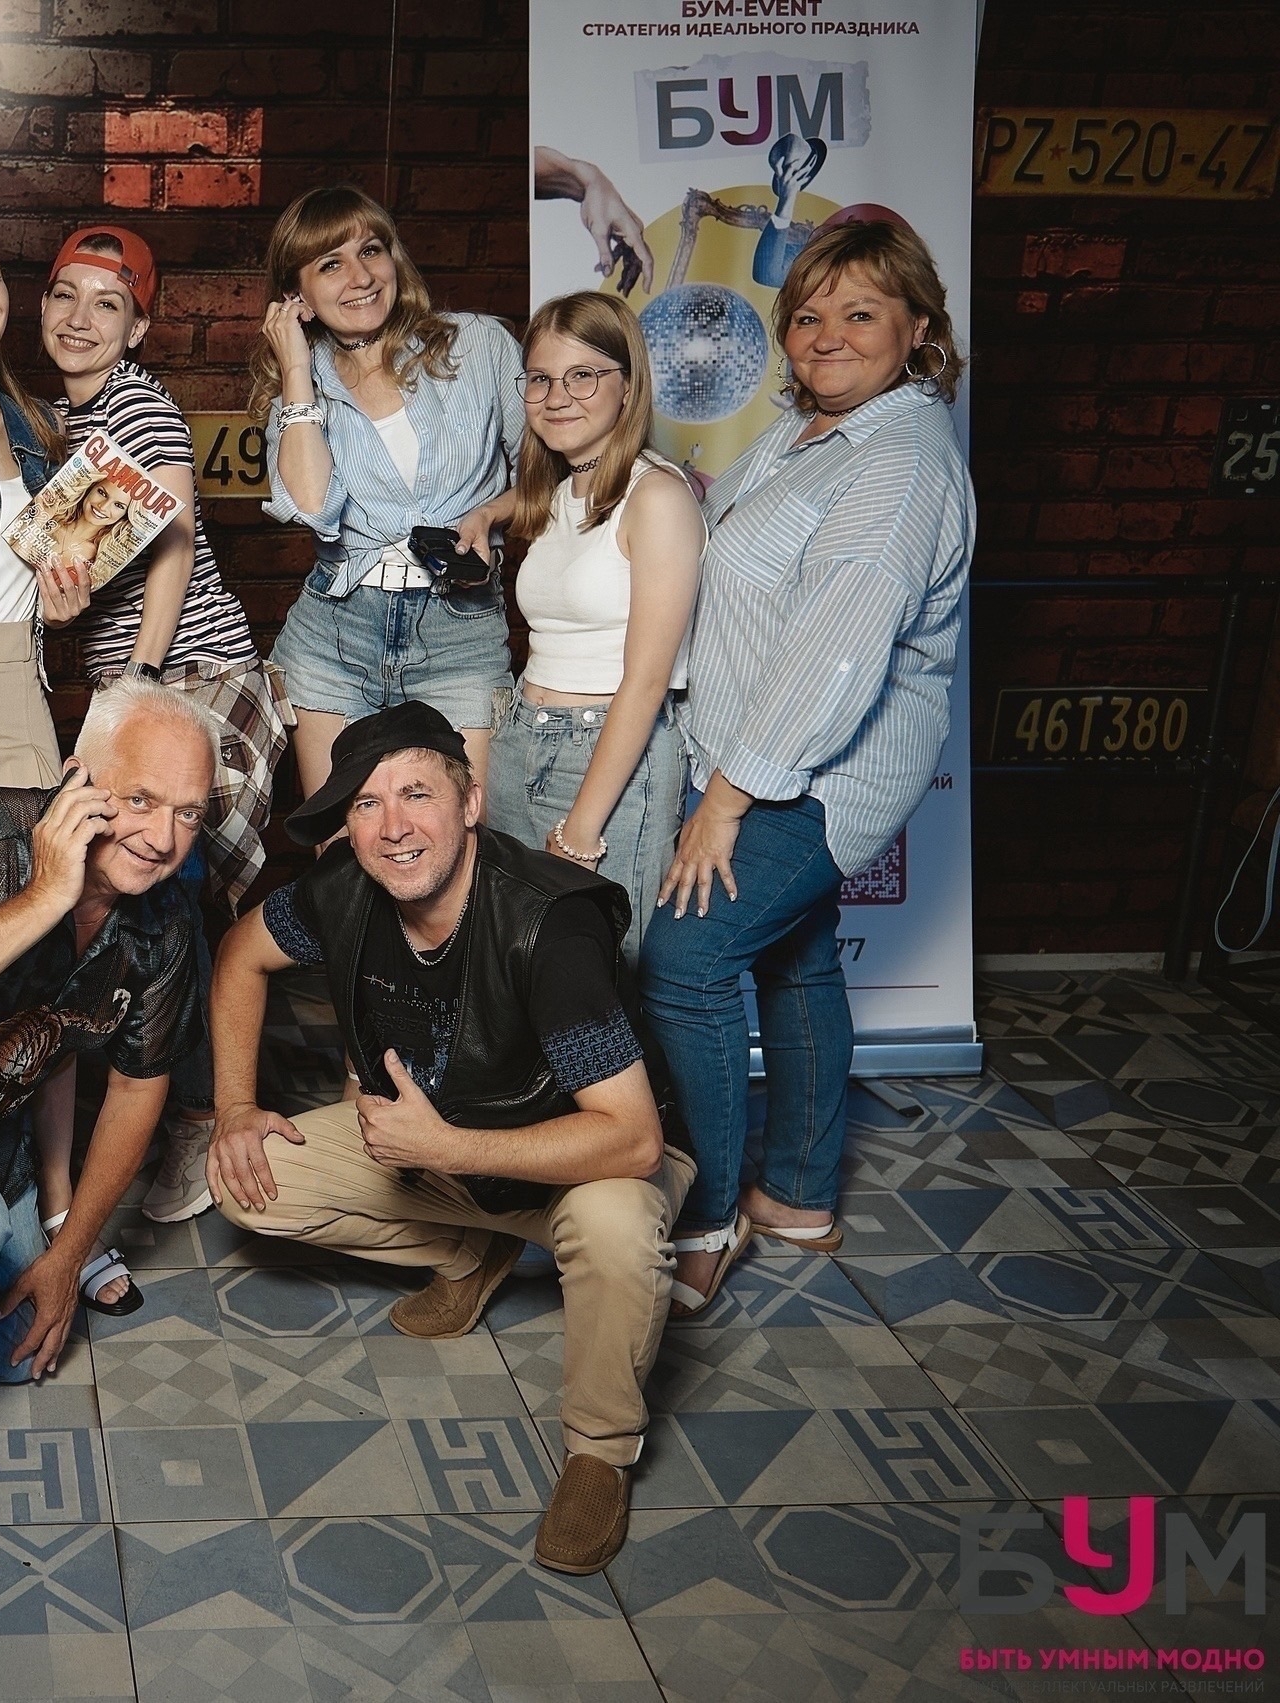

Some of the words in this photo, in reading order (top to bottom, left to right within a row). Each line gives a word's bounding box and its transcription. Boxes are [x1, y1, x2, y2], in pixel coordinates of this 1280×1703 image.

[582, 23, 681, 37] СТРАТЕГИЯ
[686, 22, 806, 38] ИДЕАЛЬНОГО
[811, 21, 920, 37] ПРАЗДНИКА
[681, 0, 821, 18] БУМ-EVENT
[656, 72, 845, 150] БУМ
[980, 117, 1055, 184] PZ
[84, 435, 177, 520] GLAMOUR
[202, 426, 268, 485] 49
[10, 528, 28, 549] НОЧЬ
[21, 512, 57, 546] РАДОСТИ
[1015, 696, 1189, 752] 46T380
